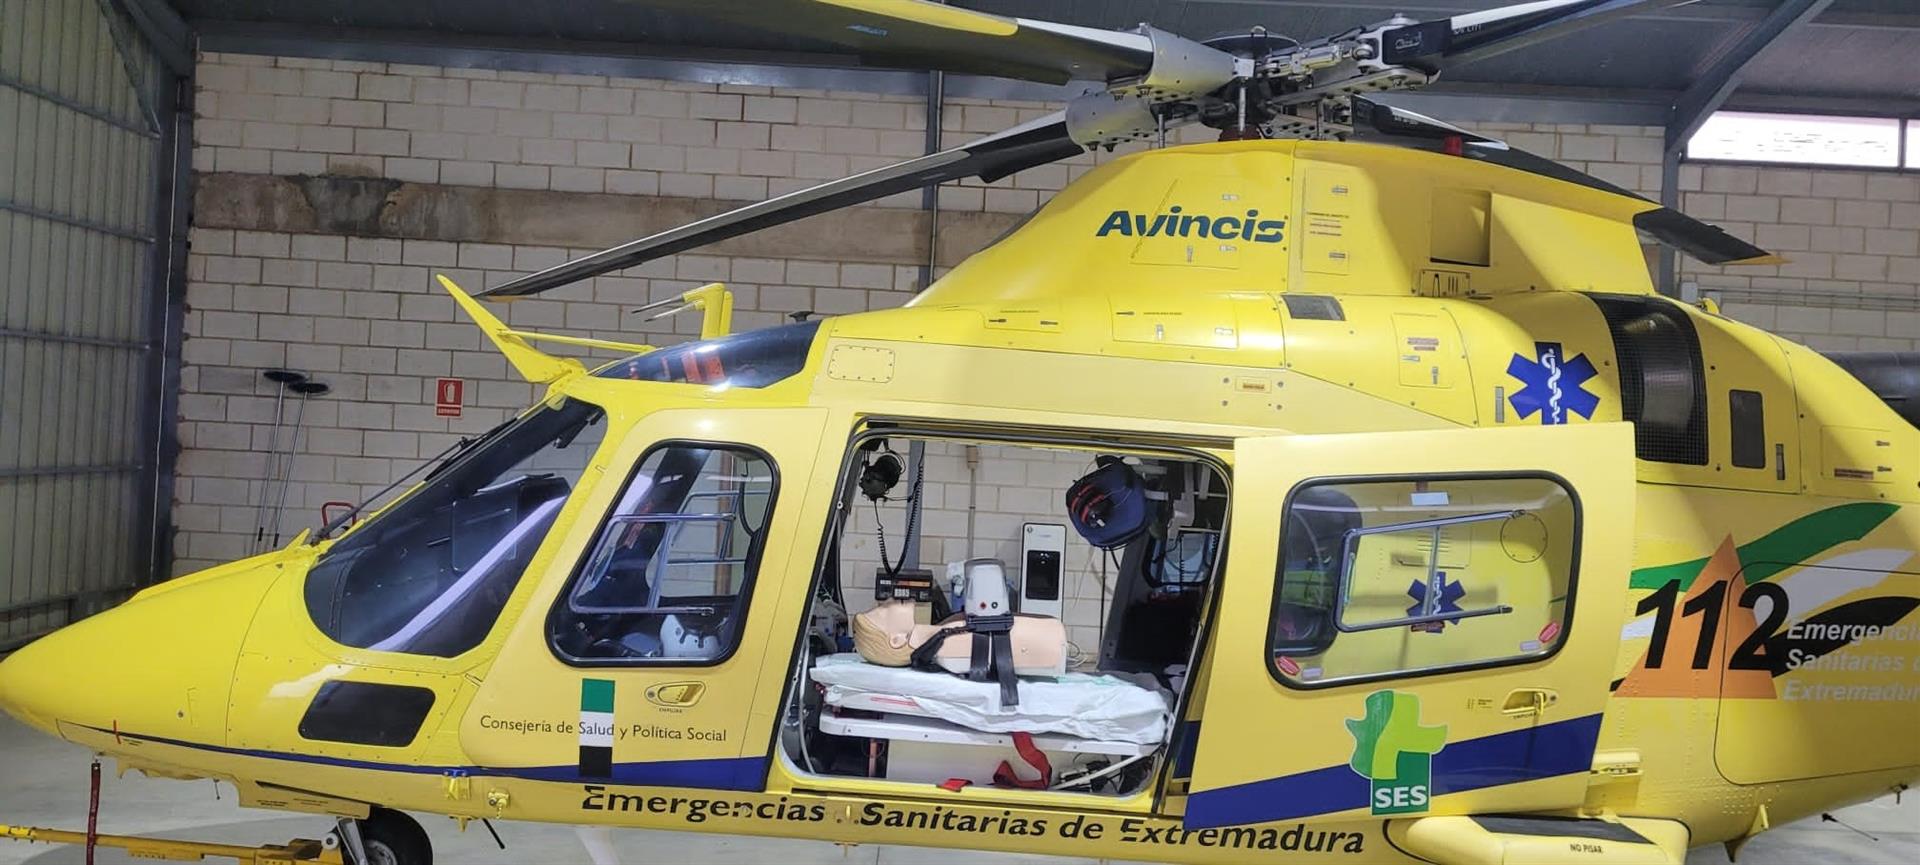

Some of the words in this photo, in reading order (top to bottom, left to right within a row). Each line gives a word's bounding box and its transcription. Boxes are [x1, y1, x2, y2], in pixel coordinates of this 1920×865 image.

[1096, 206, 1285, 243] Avincis
[1635, 578, 1789, 670] 112
[1785, 648, 1905, 671] Sanitarias
[556, 721, 573, 735] de
[578, 721, 615, 737] Salud
[619, 725, 628, 740] y
[633, 724, 682, 740] Política
[687, 727, 727, 742] Social
[1374, 785, 1427, 809] SES
[582, 785, 826, 822] Emergencias
[860, 802, 1048, 836] Sanitarias
[1059, 815, 1104, 840] de
[1120, 818, 1365, 853] Extremadura
[1570, 843, 1582, 852] NO
